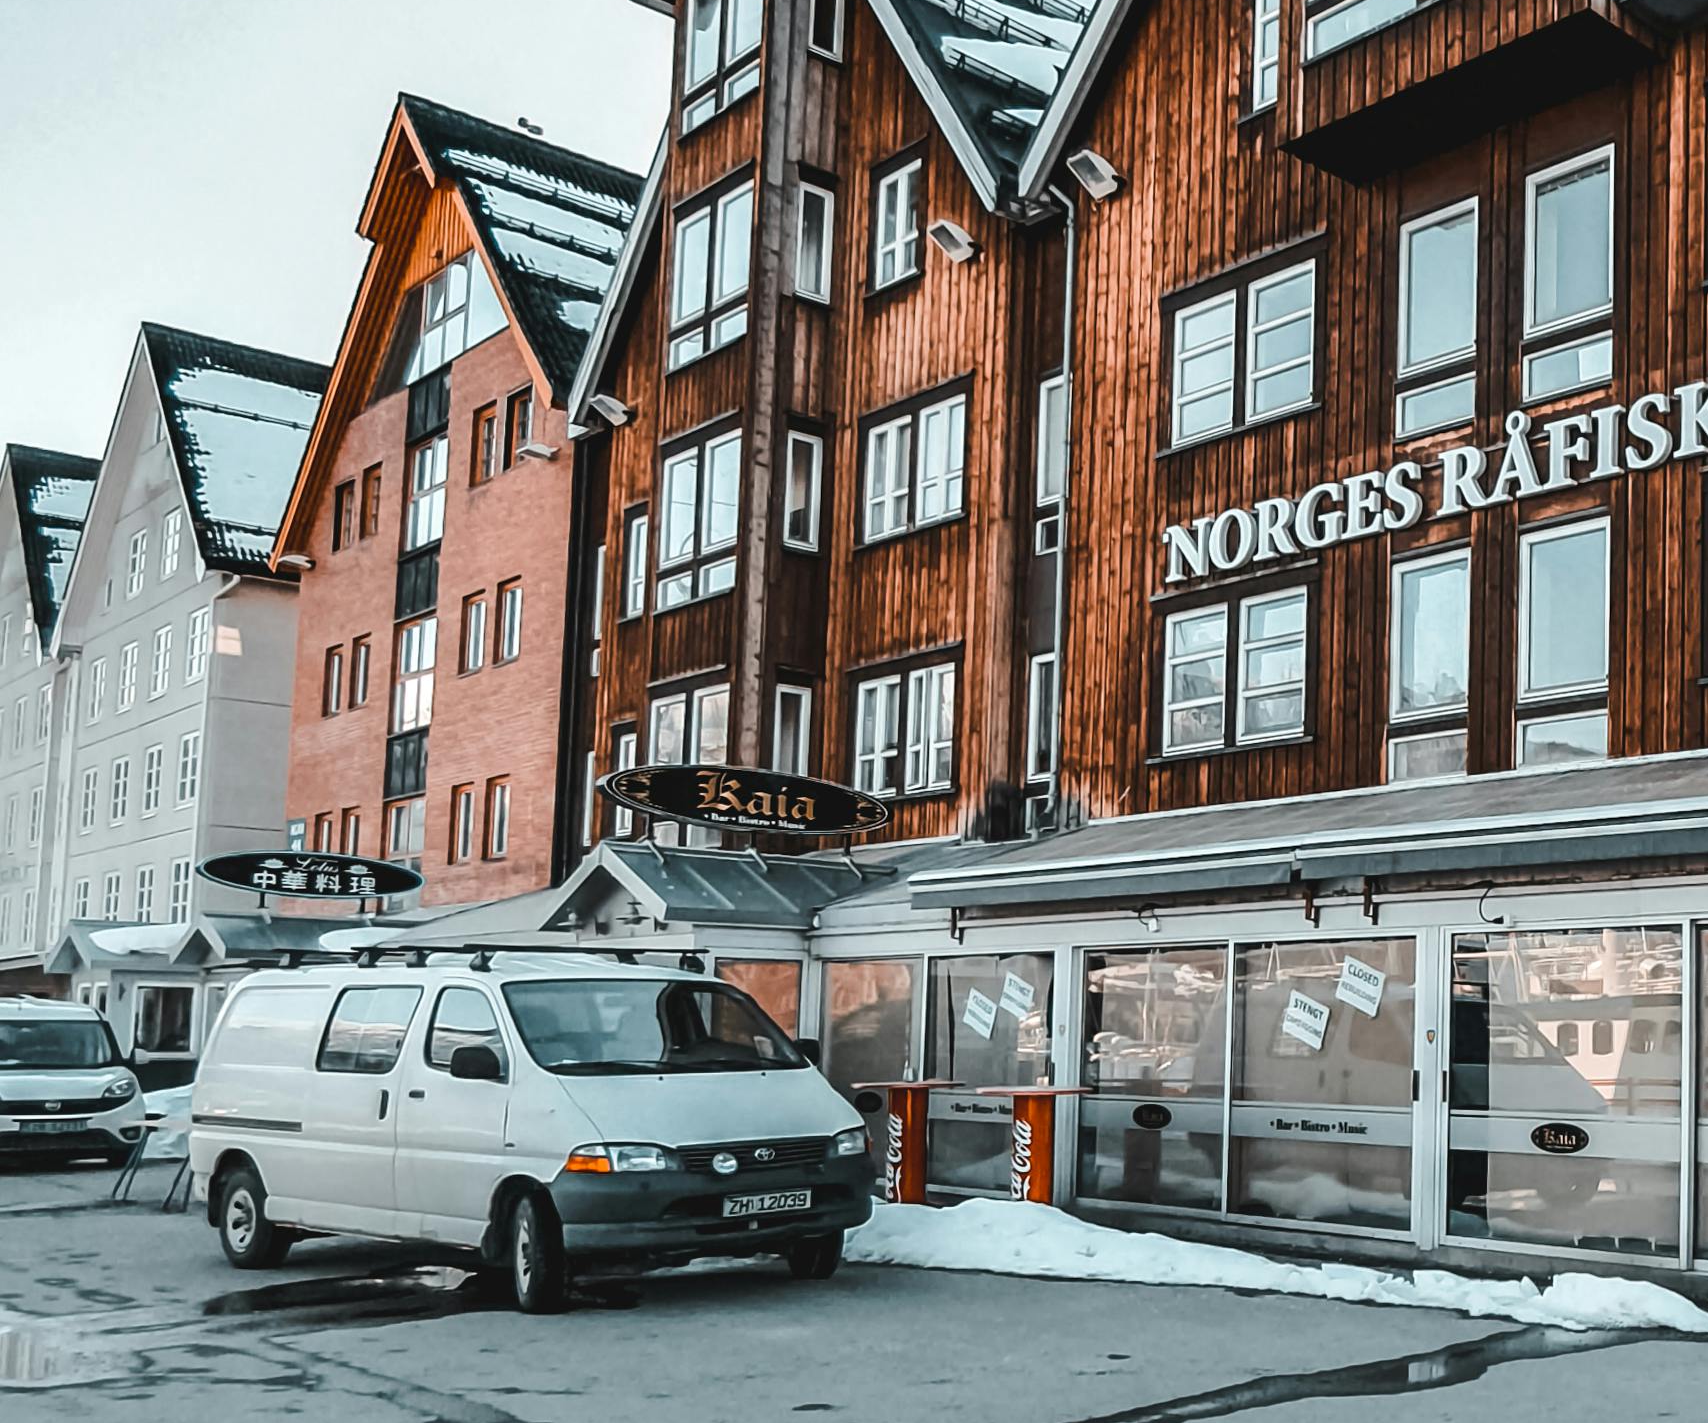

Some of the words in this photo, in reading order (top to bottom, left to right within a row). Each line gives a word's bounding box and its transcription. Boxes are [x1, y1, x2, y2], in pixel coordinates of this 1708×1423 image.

[1162, 461, 1424, 584] NORGES
[696, 770, 816, 821] Kaia
[295, 855, 340, 874] Lotus
[253, 869, 376, 895] 中華料理
[1348, 963, 1380, 987] CLOSED
[1294, 997, 1324, 1020] STENGT
[1276, 1118, 1293, 1130] Bar
[1301, 1119, 1330, 1133] Bistro
[729, 1199, 751, 1215] ZH
[758, 1193, 808, 1211] 12039
